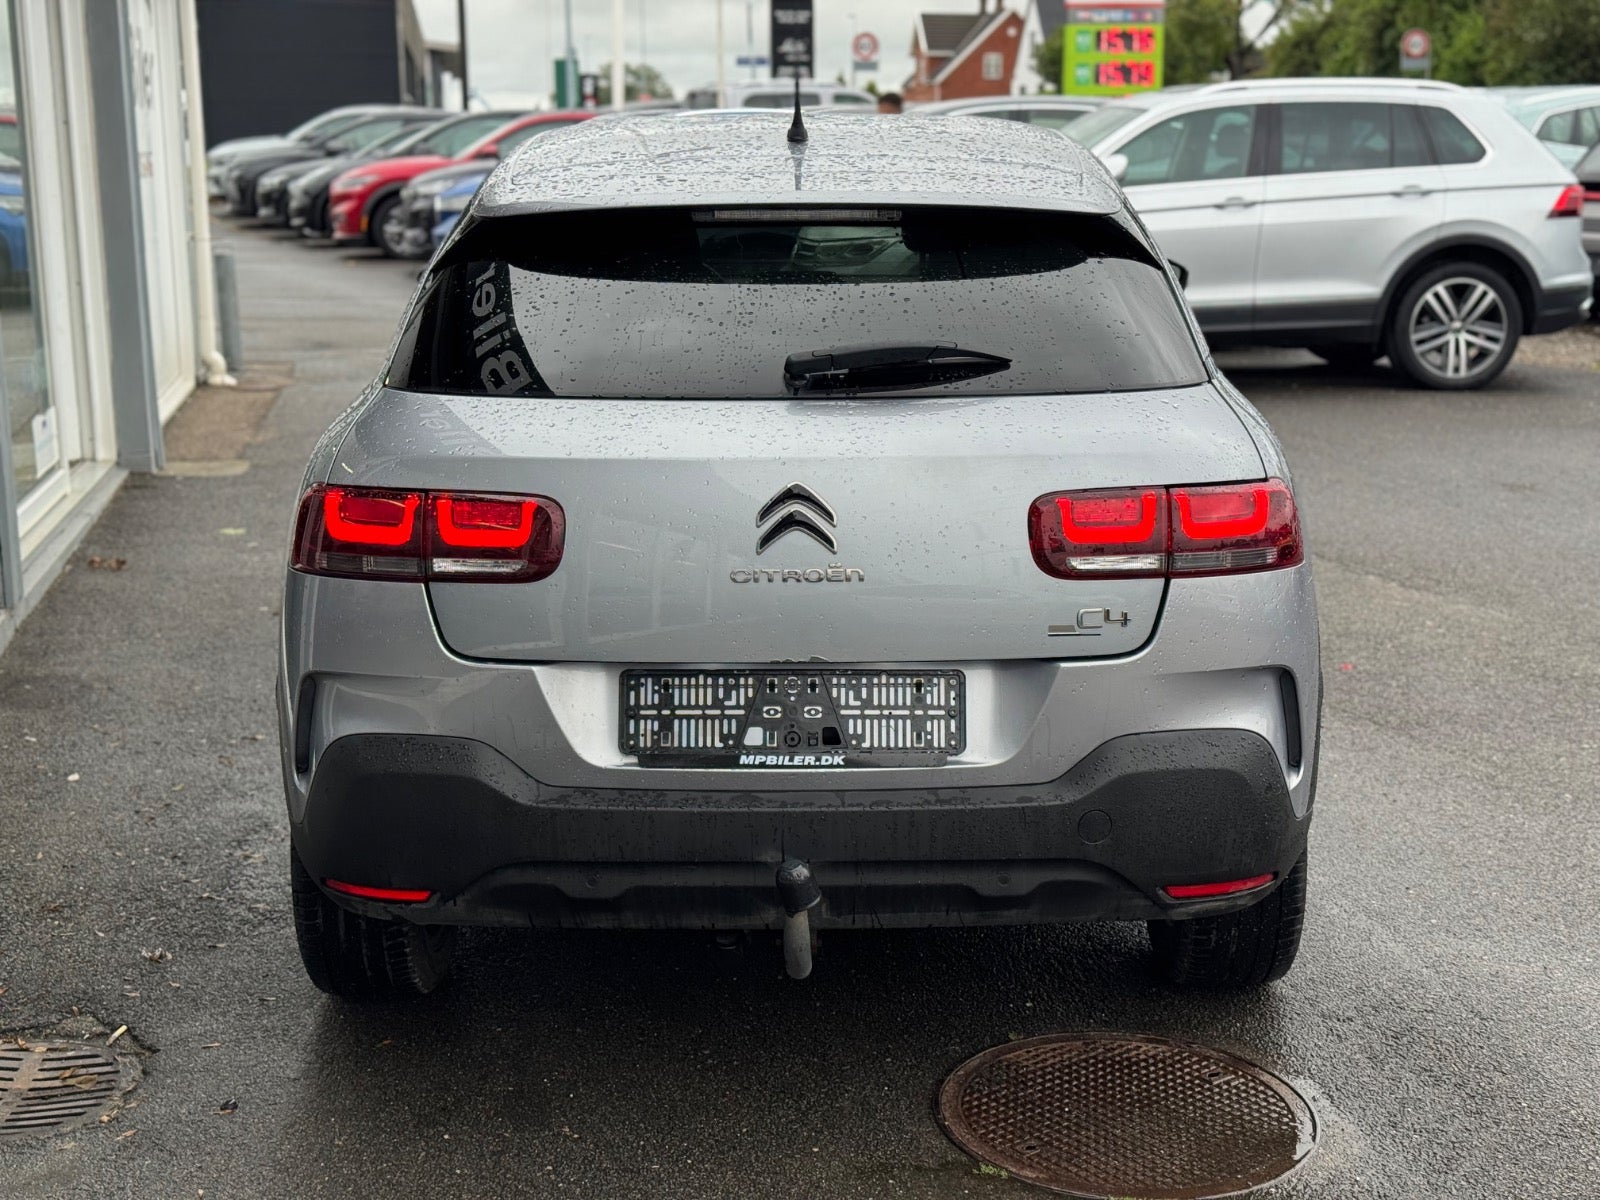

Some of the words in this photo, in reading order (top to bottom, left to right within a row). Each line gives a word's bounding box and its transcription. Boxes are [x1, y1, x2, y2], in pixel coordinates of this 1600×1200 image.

[729, 562, 865, 584] CITROËN
[1076, 607, 1131, 629] C4
[739, 755, 846, 766] MPBILER.DK
